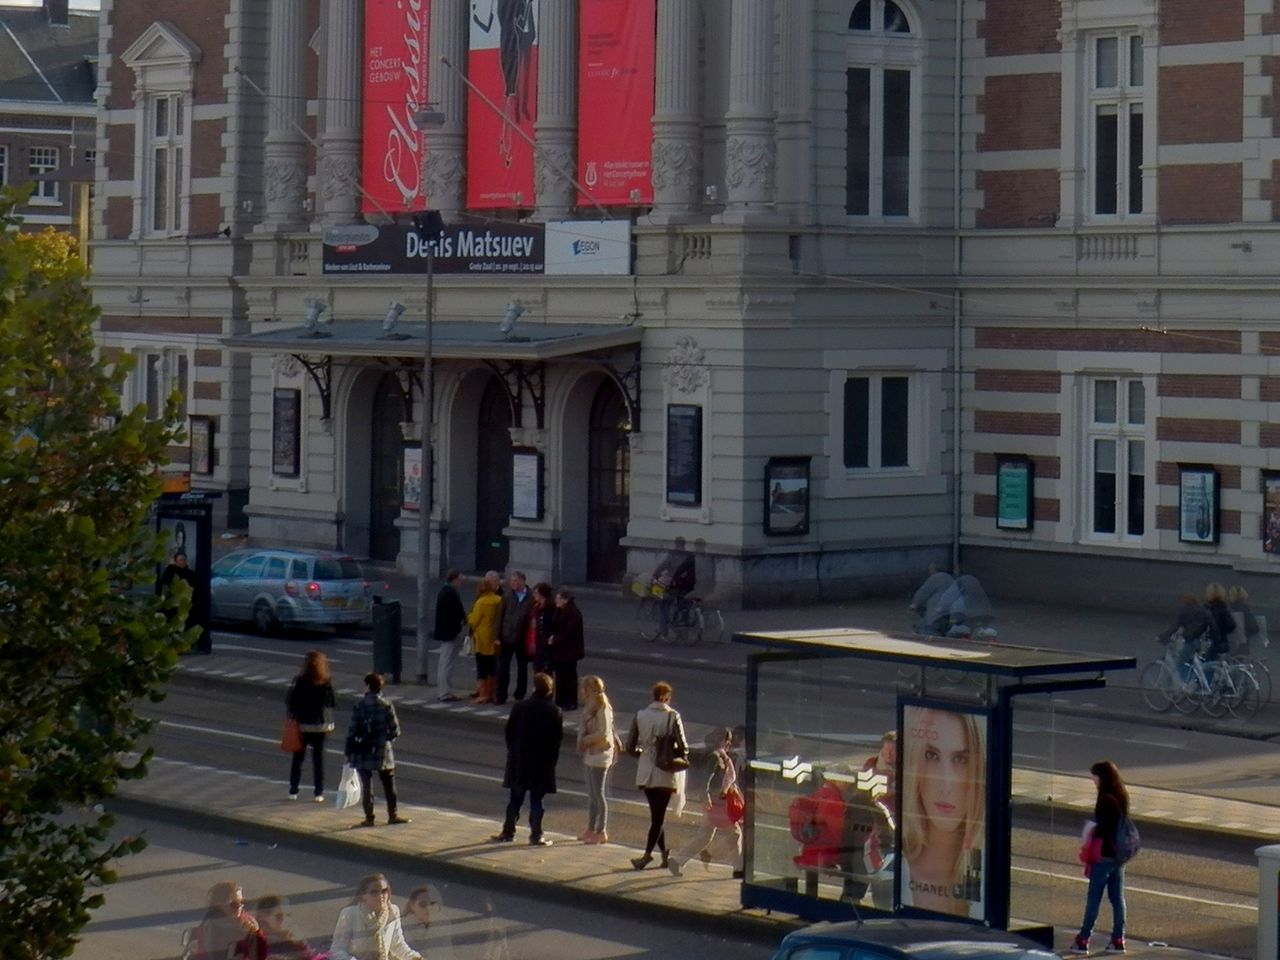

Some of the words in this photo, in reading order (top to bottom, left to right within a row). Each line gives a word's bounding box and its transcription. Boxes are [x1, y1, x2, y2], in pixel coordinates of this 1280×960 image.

[370, 47, 383, 57] HET
[369, 58, 401, 70] CONCERT
[369, 71, 400, 83] GEBOUW
[457, 230, 534, 258] Matsuev
[908, 880, 951, 898] CHANEL
